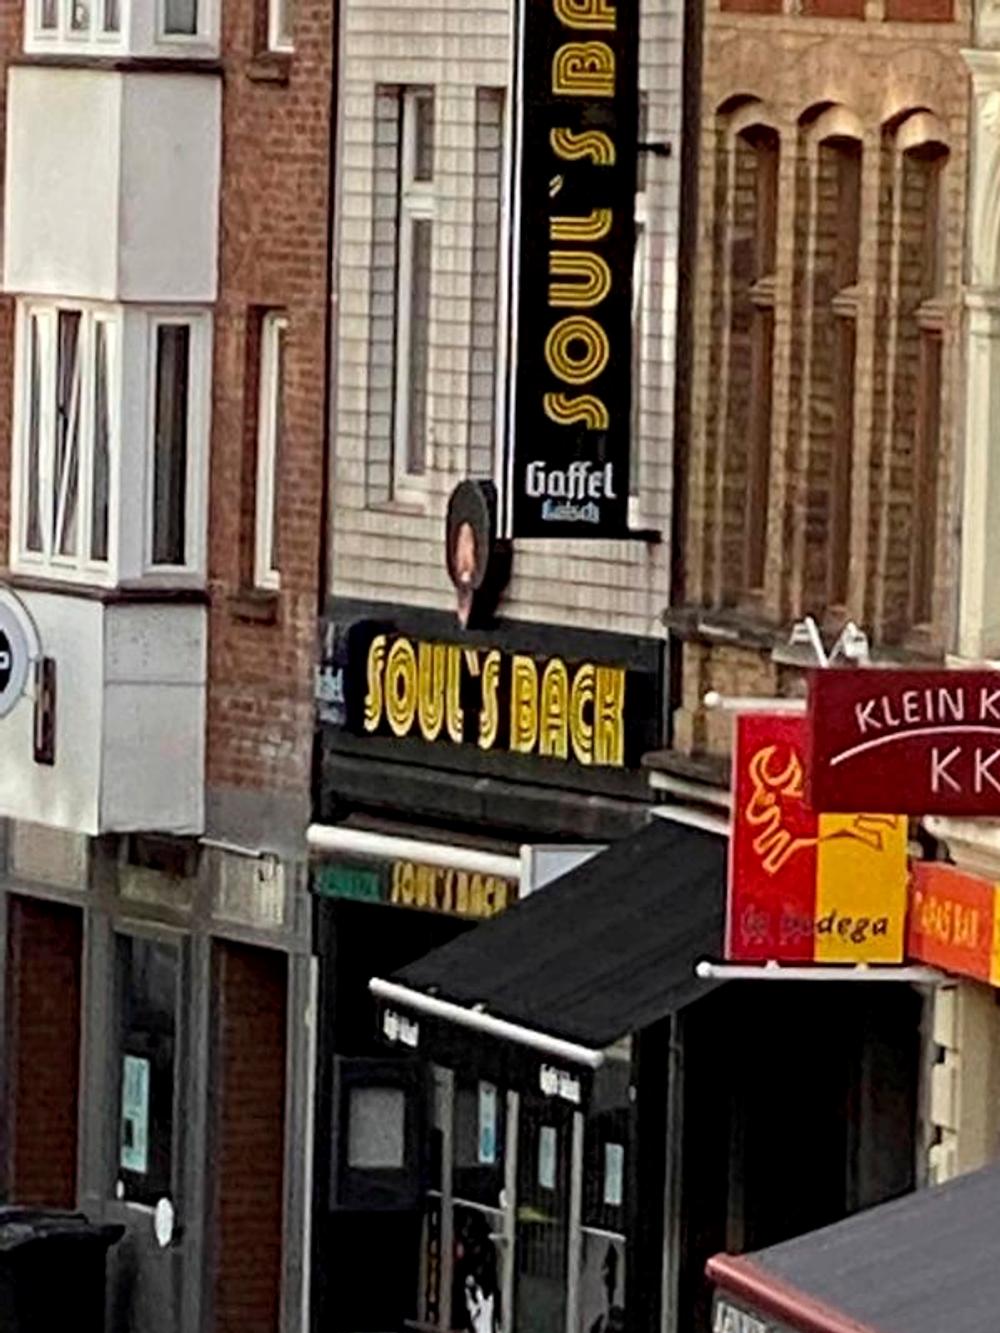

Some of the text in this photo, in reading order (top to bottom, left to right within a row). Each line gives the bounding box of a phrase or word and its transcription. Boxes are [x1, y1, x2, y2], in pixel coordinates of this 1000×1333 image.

[525, 460, 617, 499] Gaffel
[364, 634, 501, 750] SOUL'S
[510, 654, 626, 766] BACK
[855, 687, 965, 733] KLEIN
